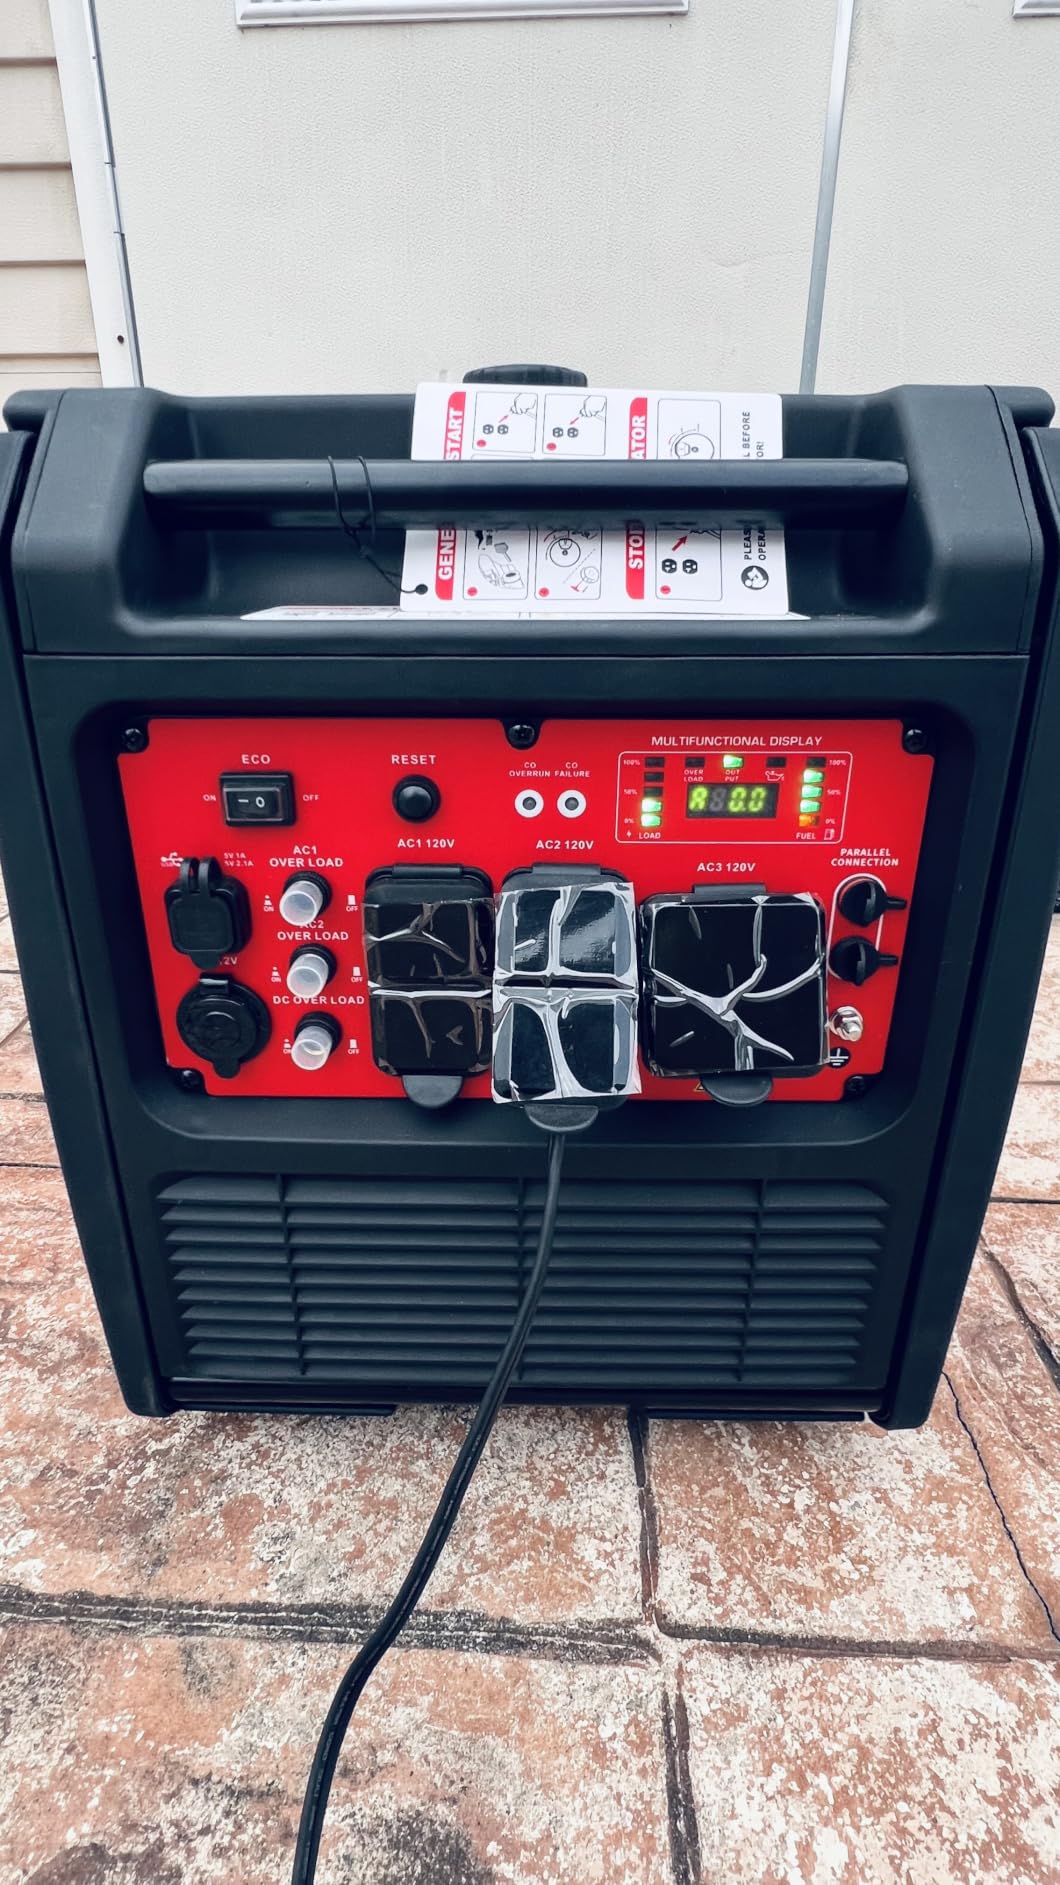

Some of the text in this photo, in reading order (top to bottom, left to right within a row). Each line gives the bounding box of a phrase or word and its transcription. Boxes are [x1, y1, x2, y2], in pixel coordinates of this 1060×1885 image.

[446, 408, 463, 460] START
[742, 412, 750, 448] BEFORE
[628, 529, 644, 569] STO
[651, 736, 822, 747] MULTIFUNCTIONAL DISPLAY
[241, 754, 271, 765] ECO
[391, 754, 436, 765] RESET
[509, 770, 550, 778] OVERRUN
[554, 770, 590, 778] FAILURE
[203, 794, 216, 802] ON
[639, 832, 661, 840] LOAD
[796, 832, 816, 840] FUEL
[397, 839, 455, 849] AC1 120V
[536, 840, 594, 850] AC2 120V
[293, 845, 317, 856] AC1
[840, 848, 891, 858] PARALLEL
[269, 858, 344, 868] OVER LOAD
[697, 862, 756, 873] AC3 120V
[831, 858, 899, 868] CONNECTION
[277, 932, 349, 941] OVER LOAD
[219, 957, 238, 966] 2V
[272, 996, 365, 1005] DC OVER LOAD
